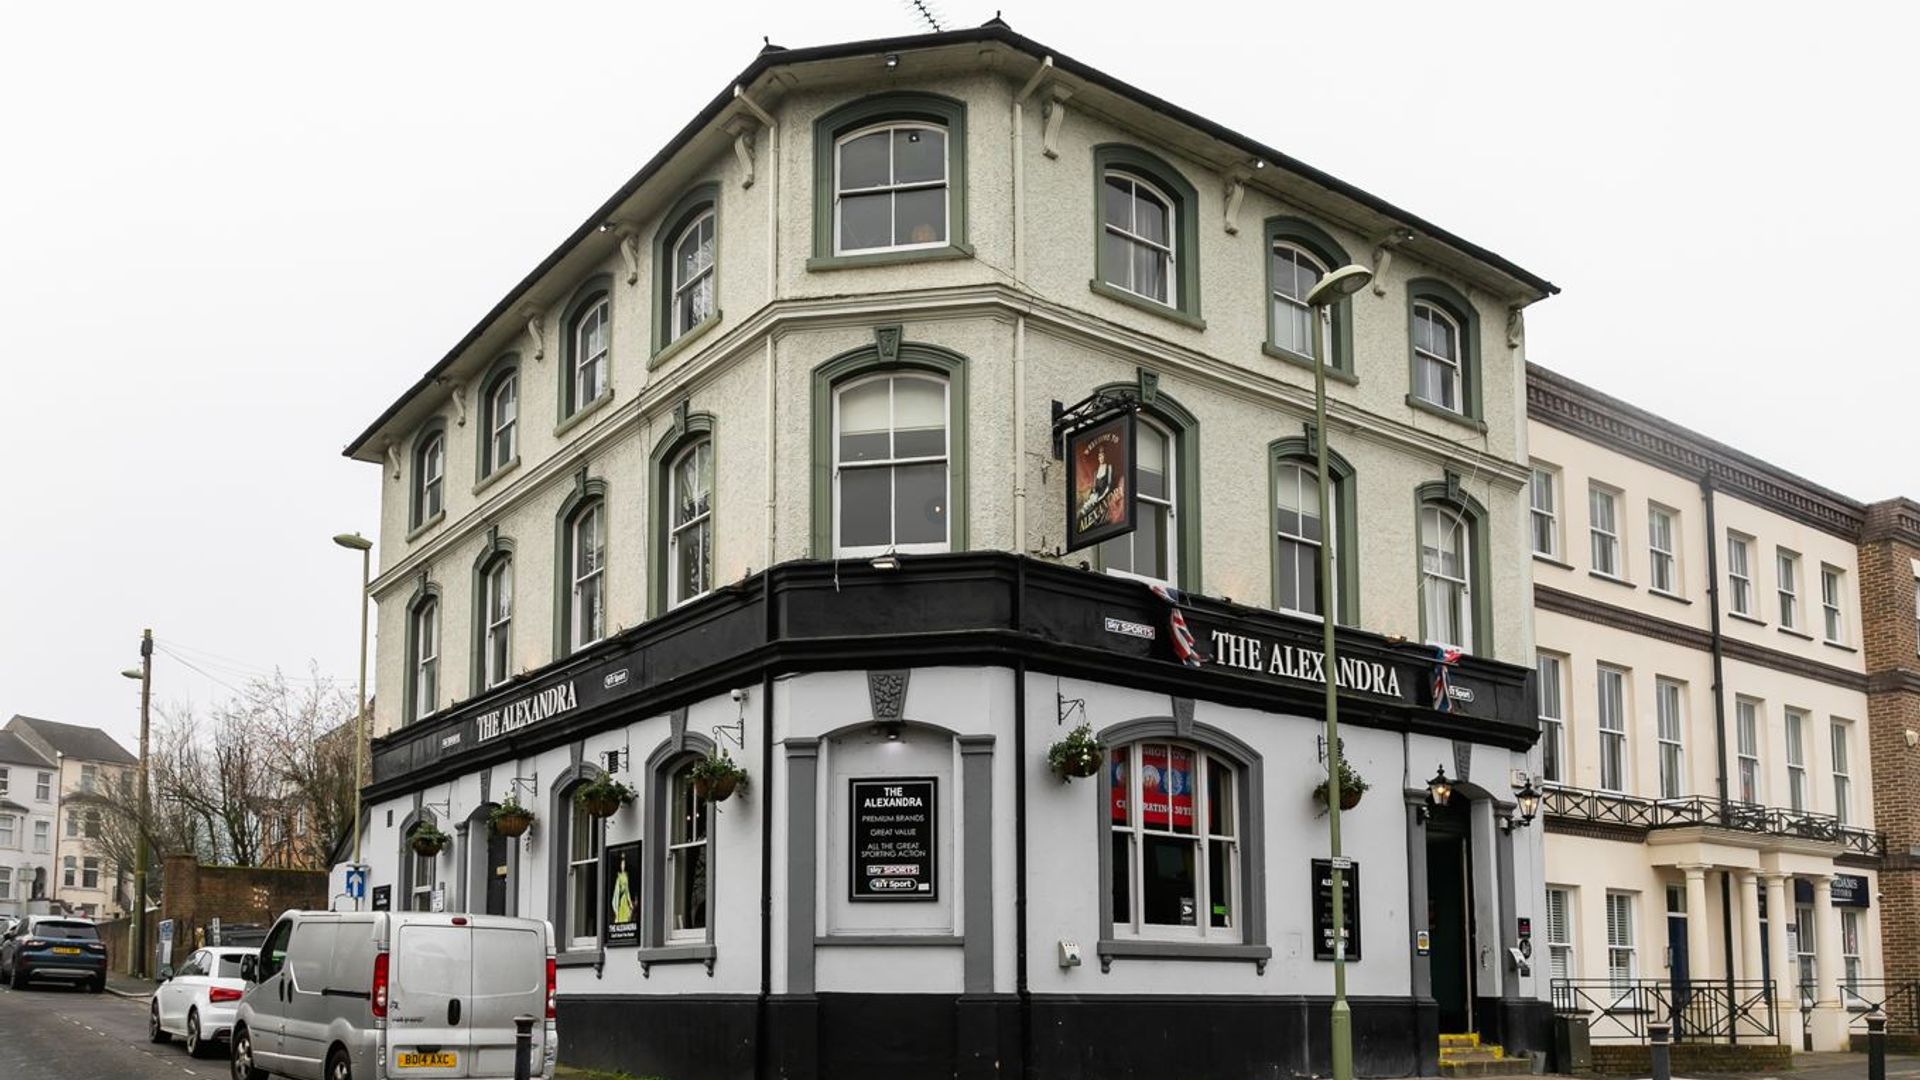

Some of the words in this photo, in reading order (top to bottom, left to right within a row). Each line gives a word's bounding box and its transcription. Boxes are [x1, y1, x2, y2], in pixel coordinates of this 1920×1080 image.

[1120, 622, 1153, 637] SPORTS
[1212, 630, 1262, 671] THE
[476, 711, 500, 742] THE
[501, 681, 577, 733] ALEXANDRA
[884, 787, 903, 797] THE
[864, 797, 923, 807] ALEXANDRA
[884, 865, 917, 873] SPORTS
[889, 880, 912, 889] Sport
[430, 1054, 449, 1064] AXC
